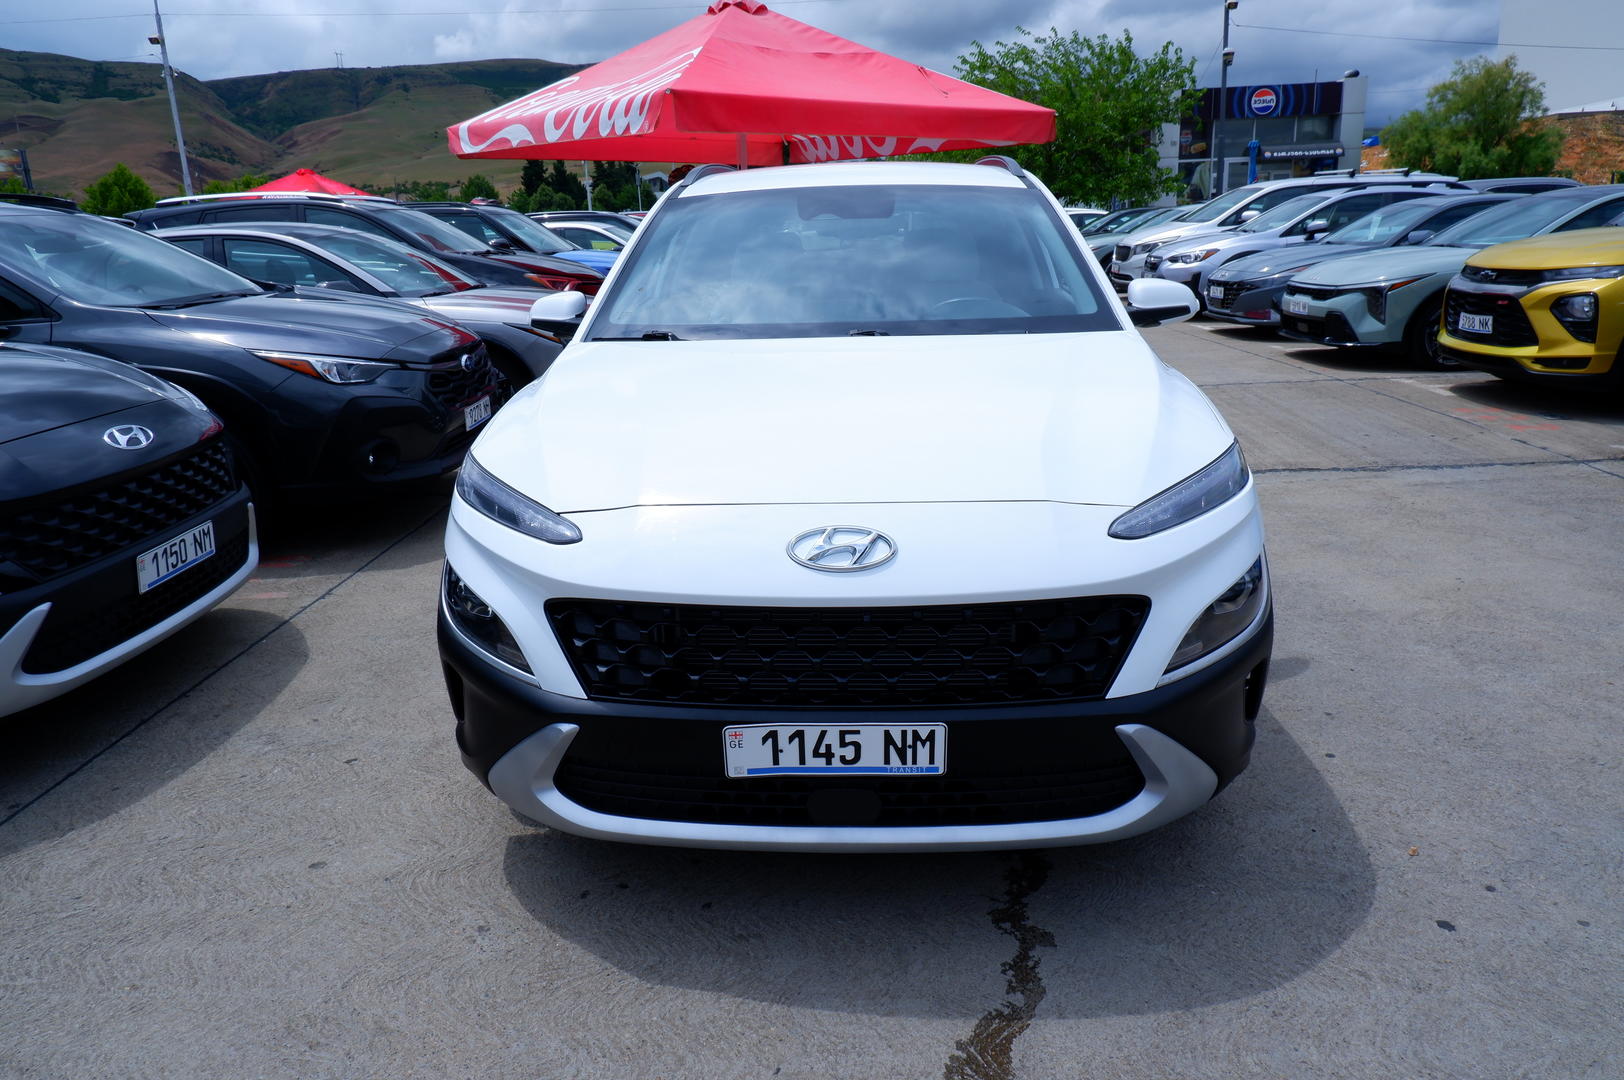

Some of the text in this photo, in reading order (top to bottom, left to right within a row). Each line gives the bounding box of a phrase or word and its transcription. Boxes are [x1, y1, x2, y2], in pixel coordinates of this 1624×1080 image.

[152, 525, 213, 578] 1150 NM
[729, 739, 744, 749] GE
[762, 729, 936, 766] 1145 NM
[886, 766, 927, 774] TRANSIT
